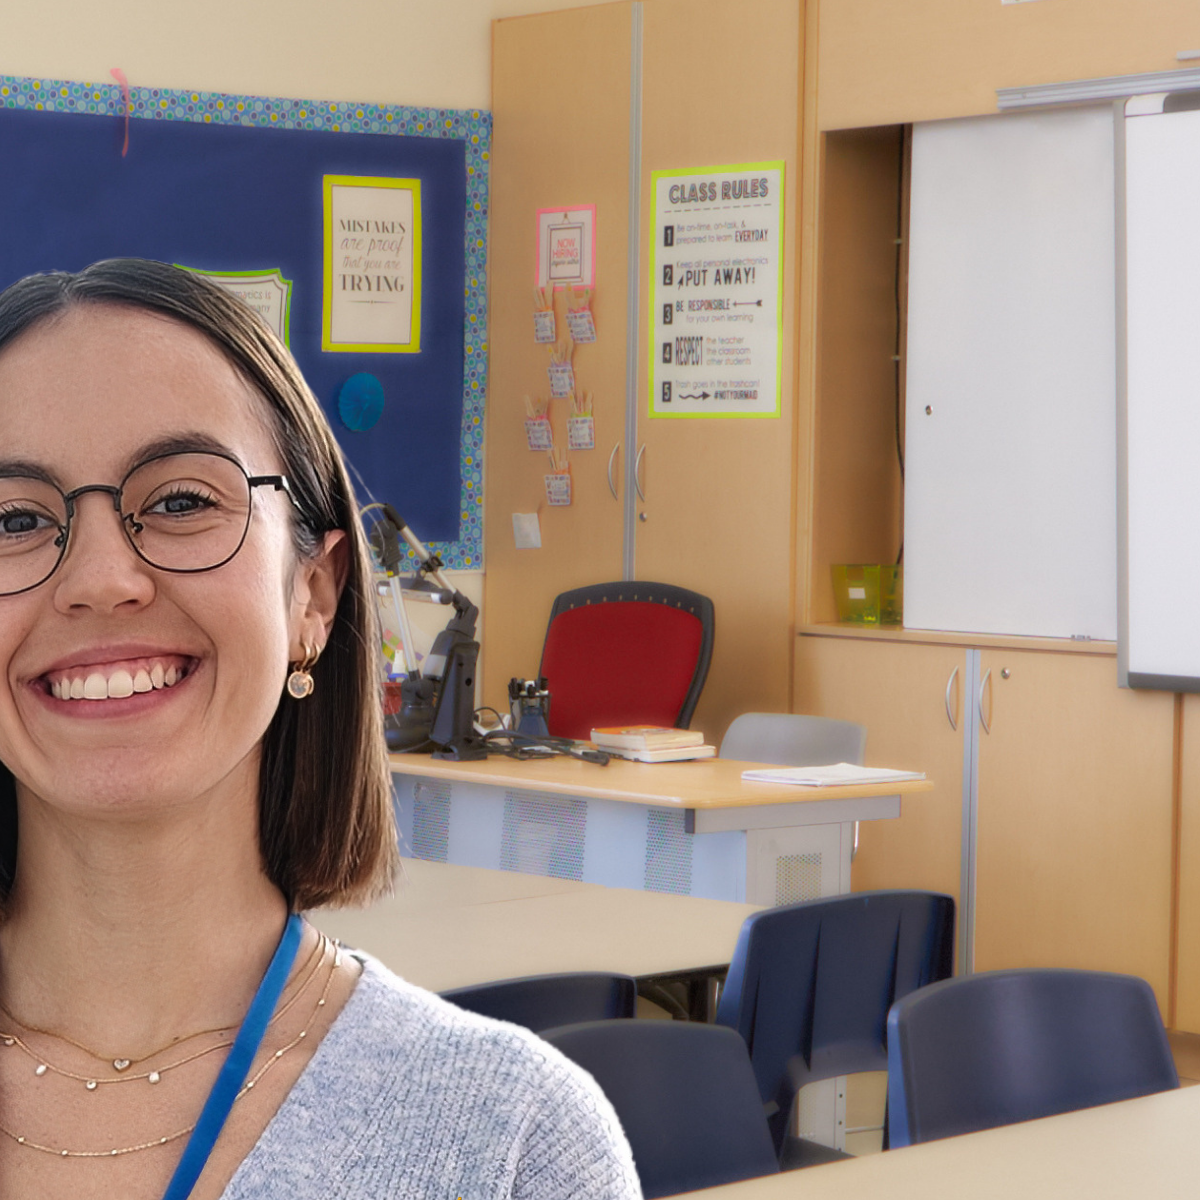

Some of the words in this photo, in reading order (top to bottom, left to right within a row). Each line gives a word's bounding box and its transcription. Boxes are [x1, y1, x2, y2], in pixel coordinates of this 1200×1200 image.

[668, 182, 717, 204] CLASS
[721, 178, 769, 200] RULES
[339, 219, 406, 234] MISTAKES
[557, 237, 576, 248] NOW
[676, 235, 707, 245] prepared
[716, 234, 732, 242] learn
[735, 228, 768, 242] EVERYDAY
[340, 236, 365, 249] are
[367, 235, 404, 254] proof
[552, 248, 579, 259] HIRING
[342, 256, 362, 269] that
[363, 257, 382, 273] you
[384, 259, 401, 269] are
[676, 260, 693, 269] Keep
[338, 273, 405, 293] TRYING
[686, 269, 708, 287] PUT
[714, 266, 755, 286] AWAY!
[676, 300, 684, 312] BE
[688, 298, 730, 312] RESPONSIBLE
[686, 314, 695, 323] for
[696, 316, 709, 324] your
[711, 315, 725, 323] own
[726, 313, 754, 324] learning
[718, 336, 745, 344] teacher
[675, 336, 703, 366] RESPECT
[706, 347, 717, 355] the
[718, 347, 751, 355] classroom
[706, 358, 723, 366] other
[725, 357, 751, 366] students
